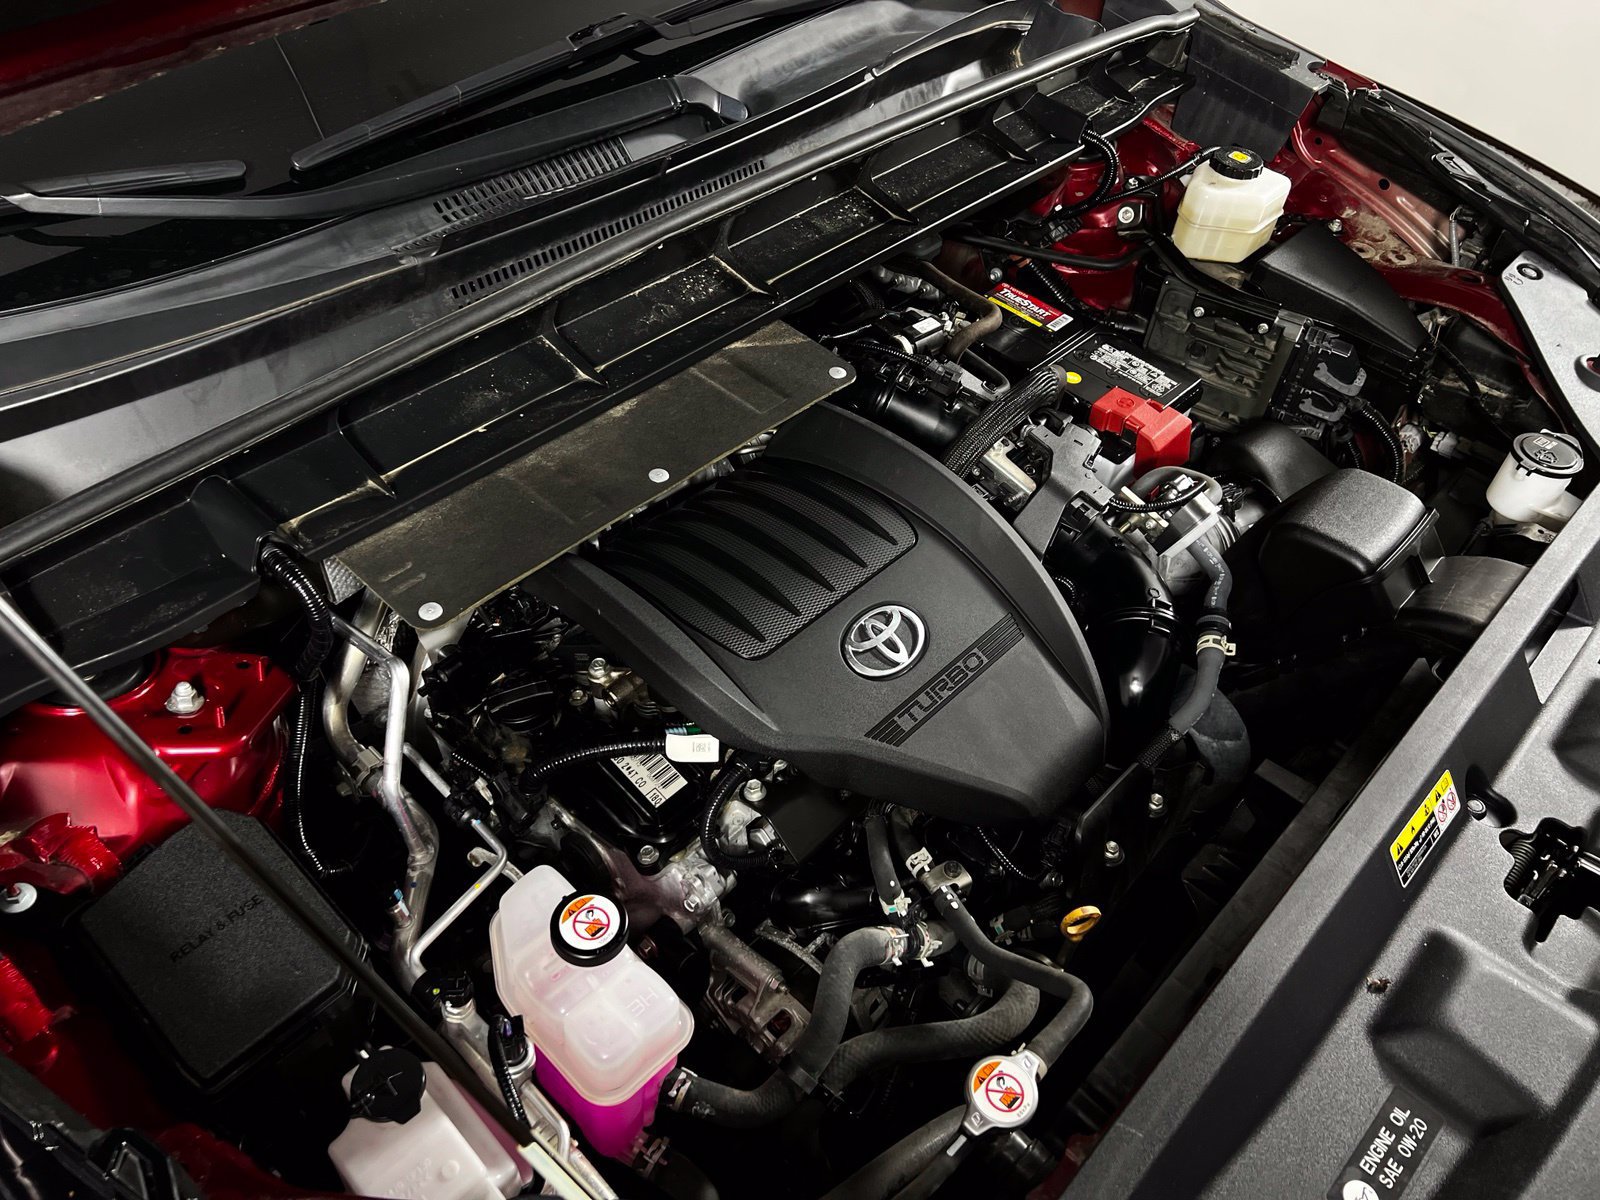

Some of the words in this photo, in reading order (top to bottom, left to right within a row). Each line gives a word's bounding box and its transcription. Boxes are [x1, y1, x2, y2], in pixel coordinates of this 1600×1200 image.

[897, 651, 984, 723] TURBO
[170, 928, 214, 963] RELAY
[216, 920, 226, 931] &
[227, 894, 265, 923] FUSE
[1359, 1126, 1396, 1176] ENGINE
[1389, 1106, 1411, 1127] OIL
[1378, 1157, 1404, 1190] SAE
[1397, 1117, 1429, 1158] 0W-20
